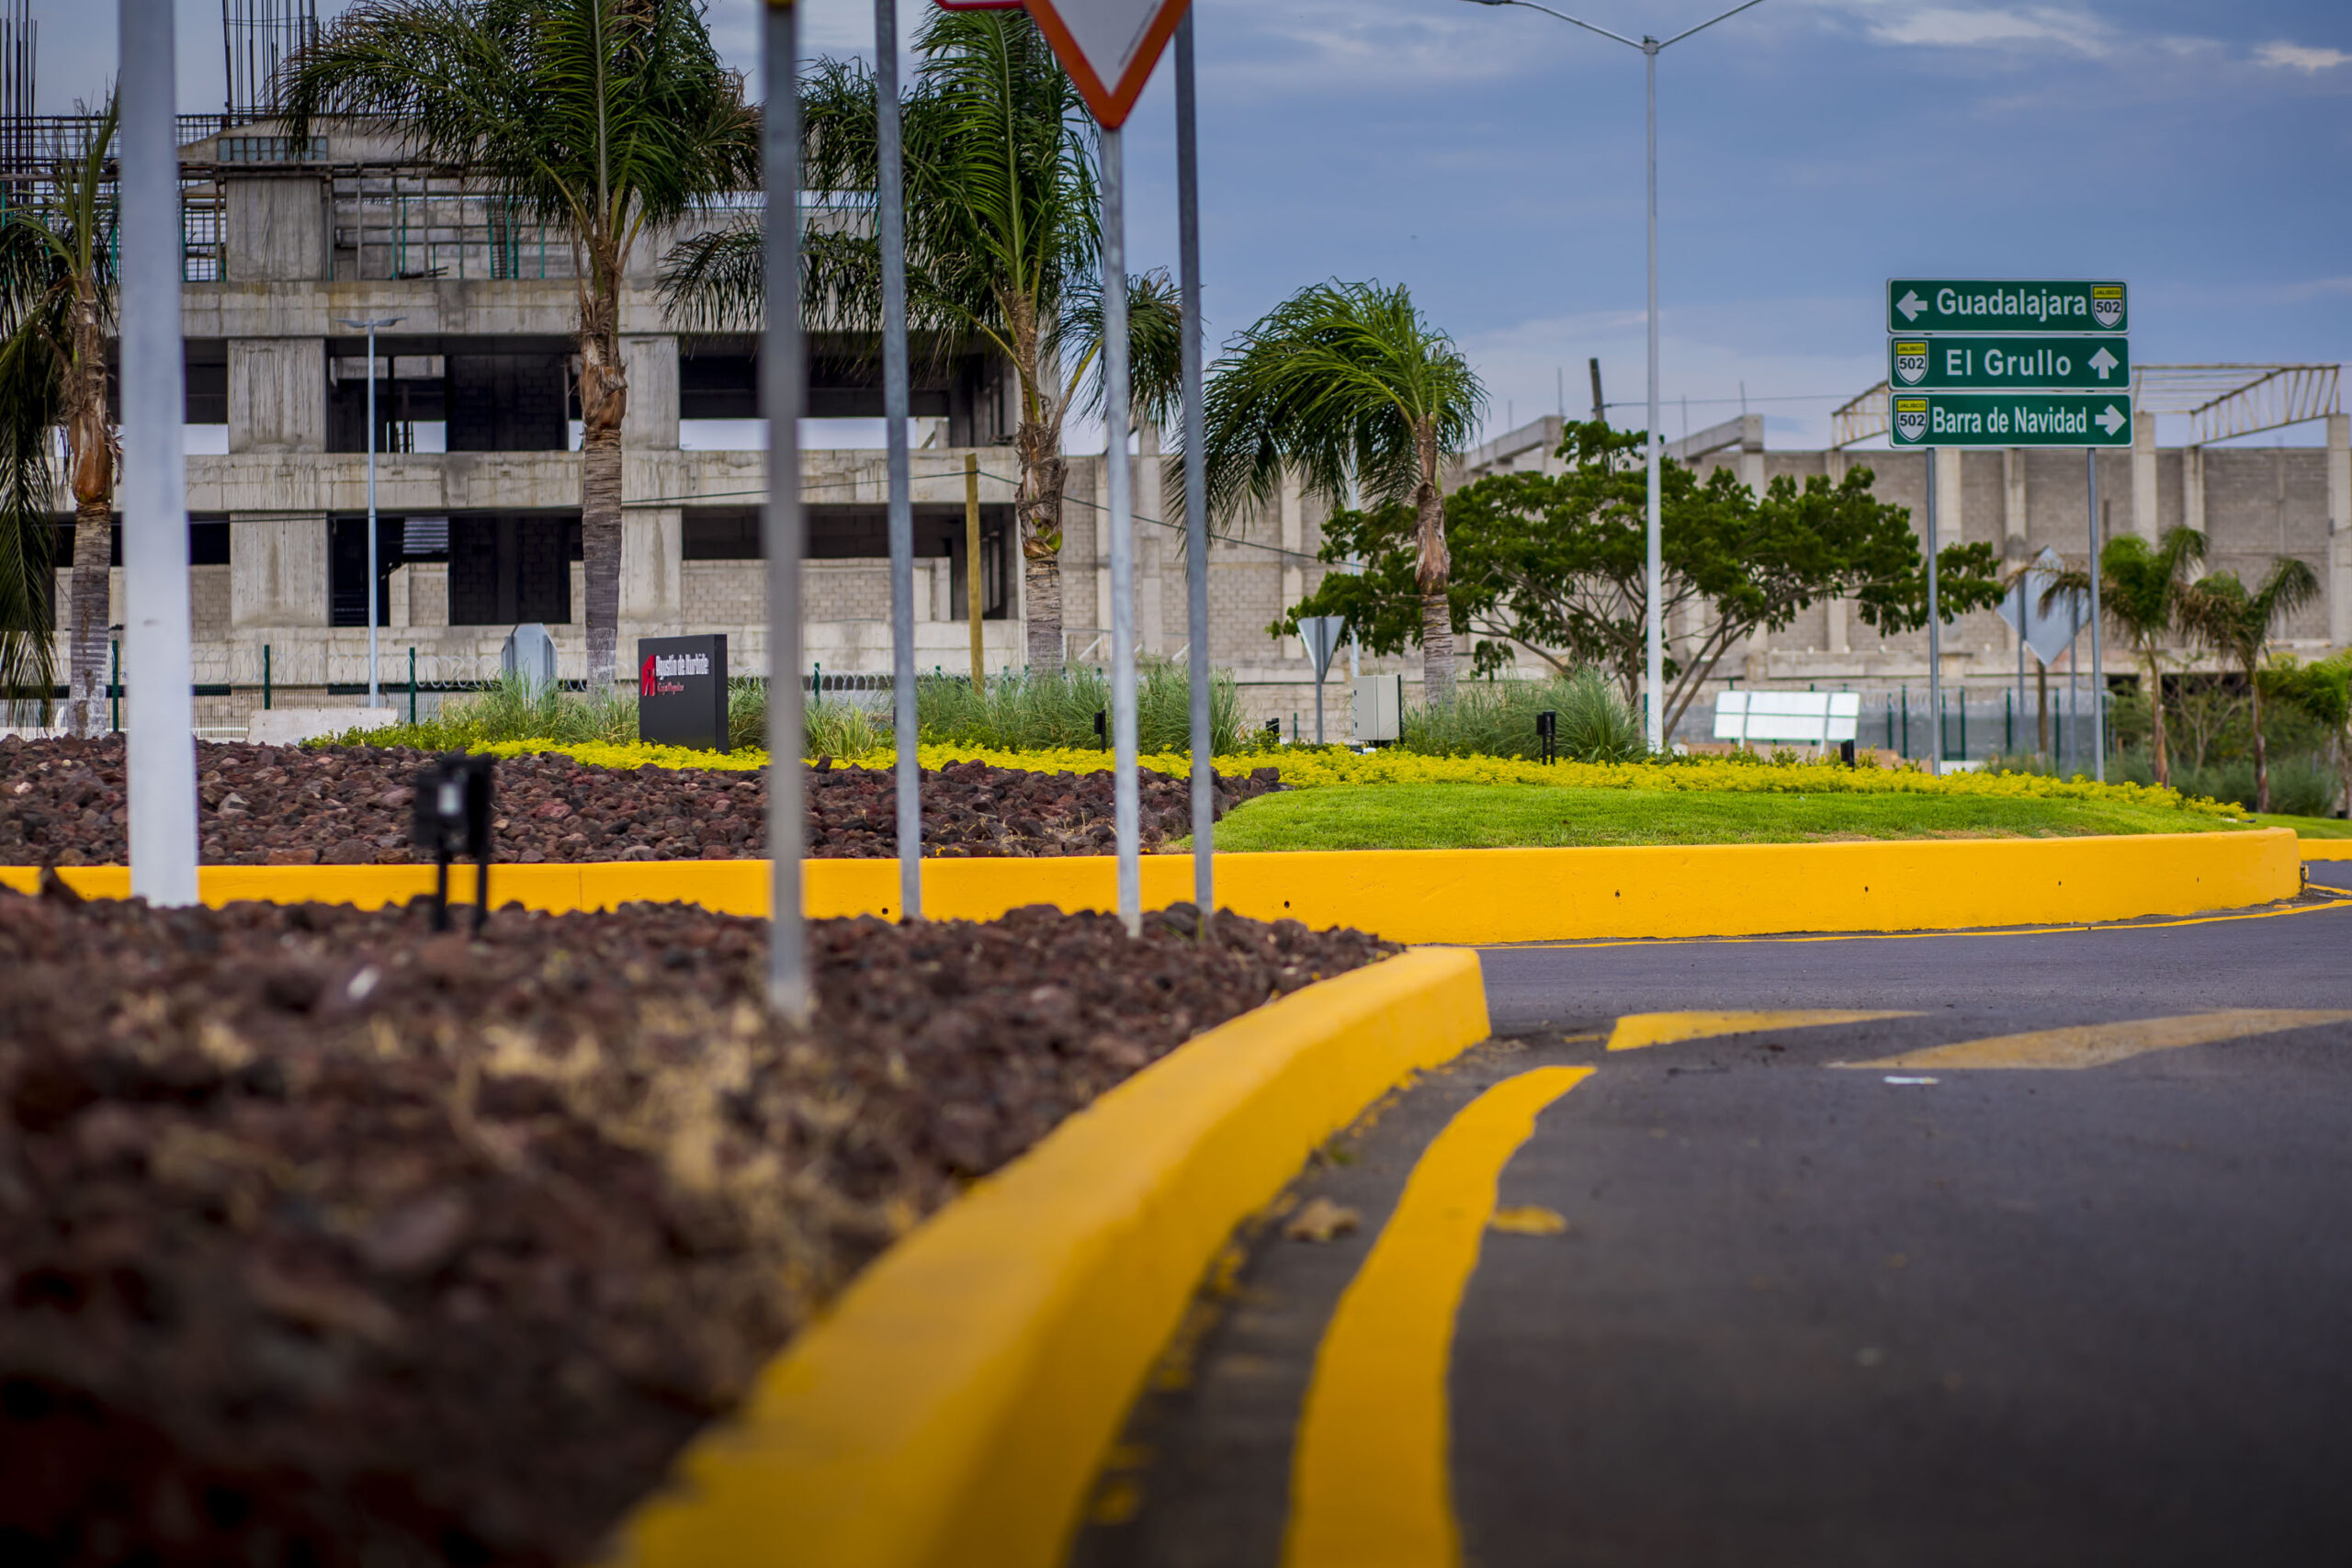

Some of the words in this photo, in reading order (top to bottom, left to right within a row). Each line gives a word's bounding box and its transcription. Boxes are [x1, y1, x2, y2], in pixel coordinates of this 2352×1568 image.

[1937, 288, 2087, 321] Guadalajara
[2096, 301, 2120, 313] 502
[1899, 357, 1925, 369] 502
[1946, 349, 1972, 376] El
[1984, 348, 2072, 376] Grullo
[1899, 414, 1925, 426] 502
[1932, 406, 1982, 434] Barra
[1987, 406, 2009, 434] de
[2015, 406, 2087, 434] Navidad
